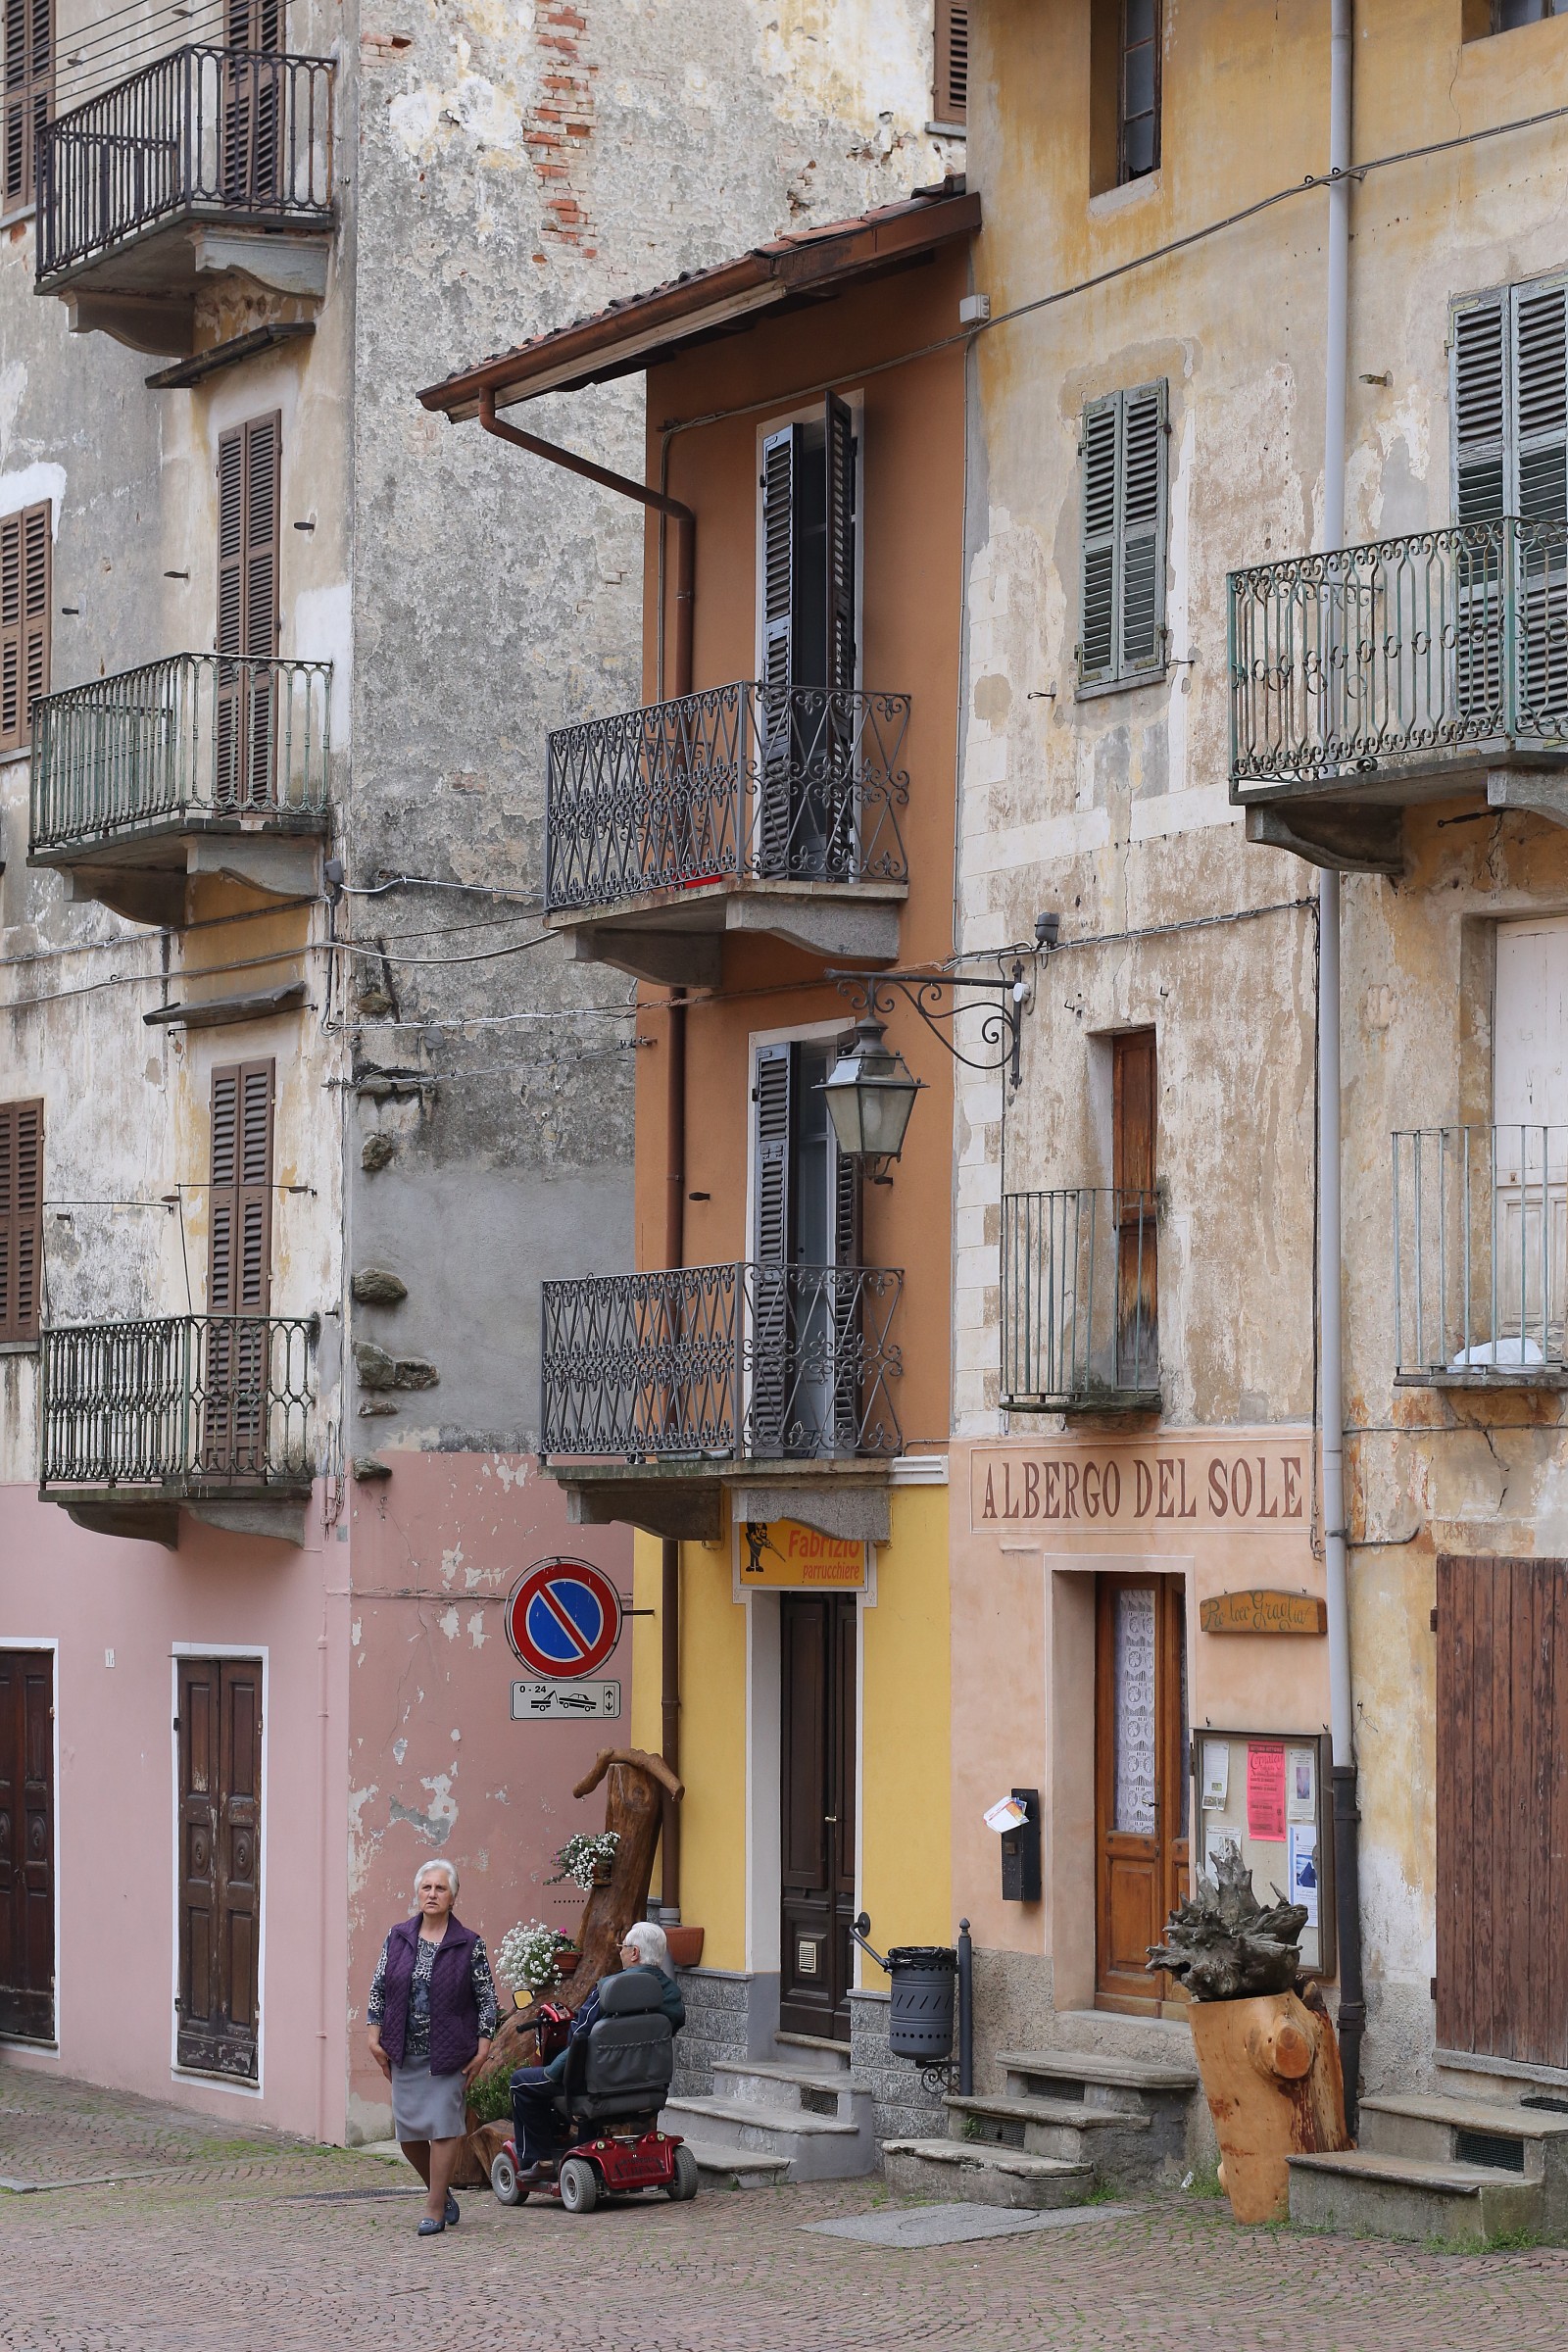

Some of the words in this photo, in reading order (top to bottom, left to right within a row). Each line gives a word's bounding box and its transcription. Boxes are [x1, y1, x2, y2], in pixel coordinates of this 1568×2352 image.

[981, 1460, 1122, 1519] ALBERGO
[1133, 1458, 1197, 1518] DEL
[1208, 1457, 1303, 1518] SOLE
[788, 1530, 860, 1558] Fabrizio
[803, 1562, 859, 1580] parrucchiere
